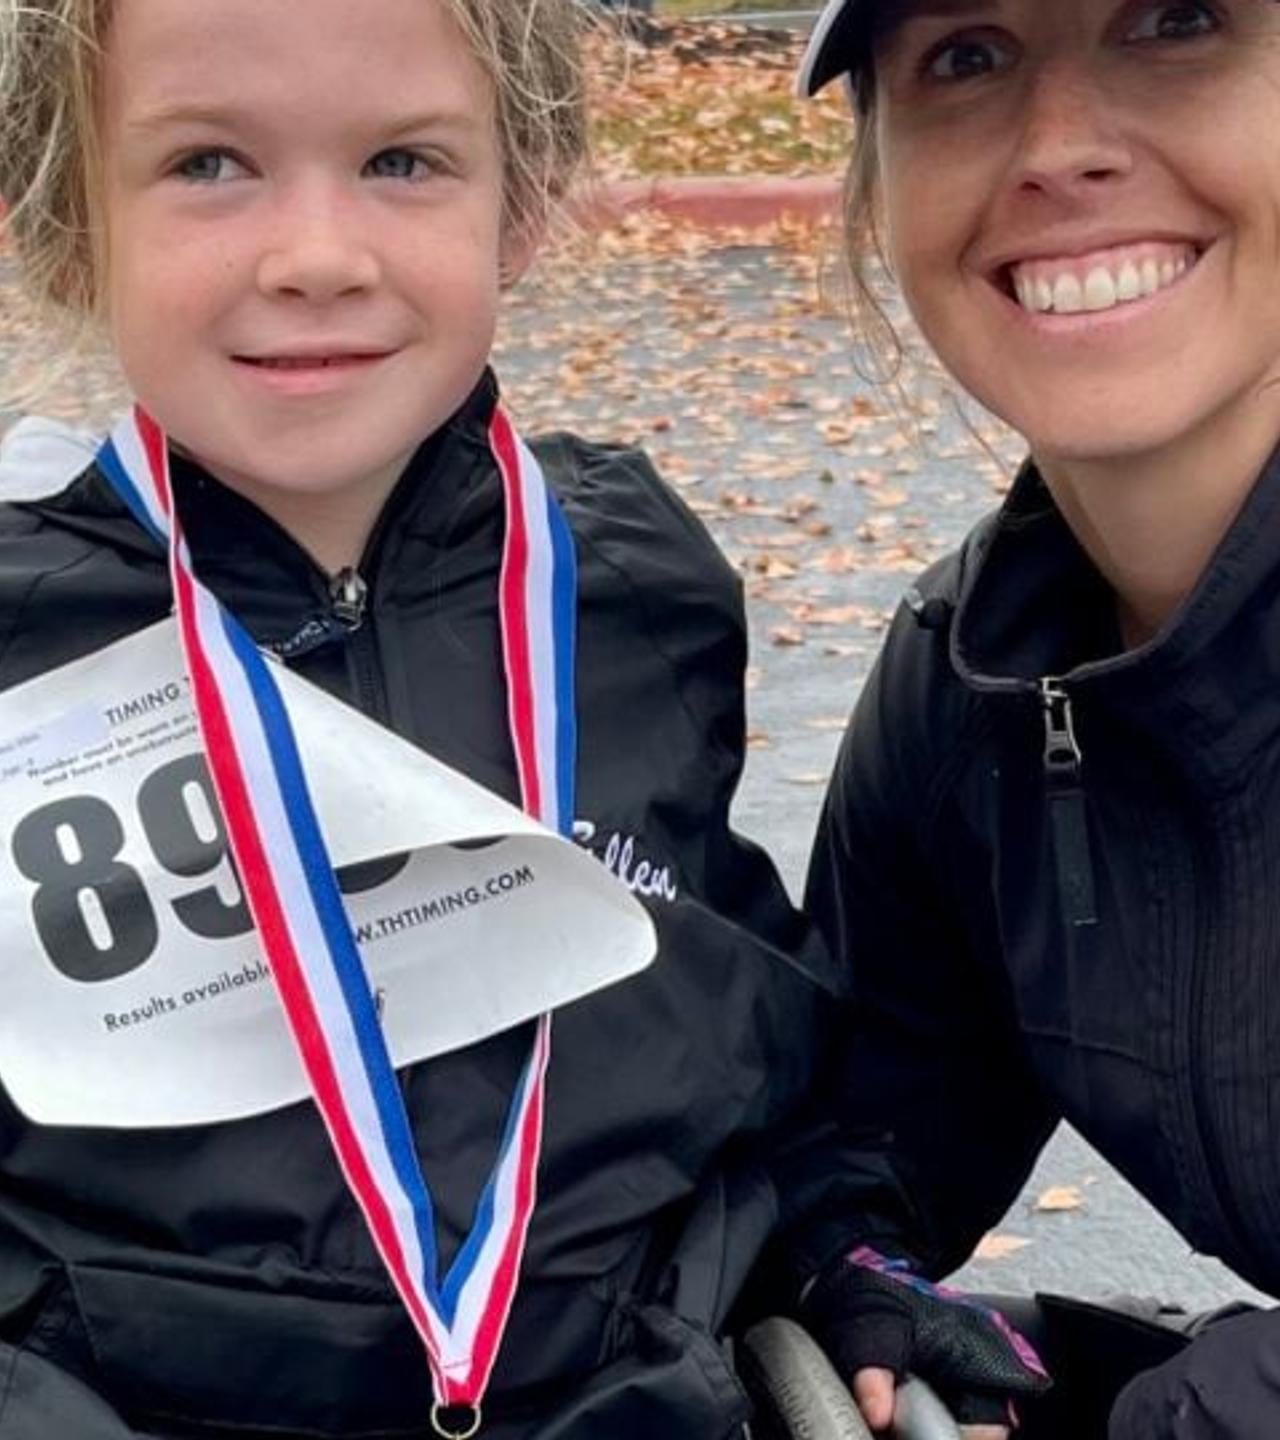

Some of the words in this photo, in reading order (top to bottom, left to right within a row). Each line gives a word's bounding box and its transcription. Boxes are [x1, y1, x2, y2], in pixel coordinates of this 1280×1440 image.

[105, 683, 181, 726] TIMING
[573, 820, 677, 903] llen
[354, 863, 536, 943] W.THTIMING.COM
[103, 992, 178, 1033] Results
